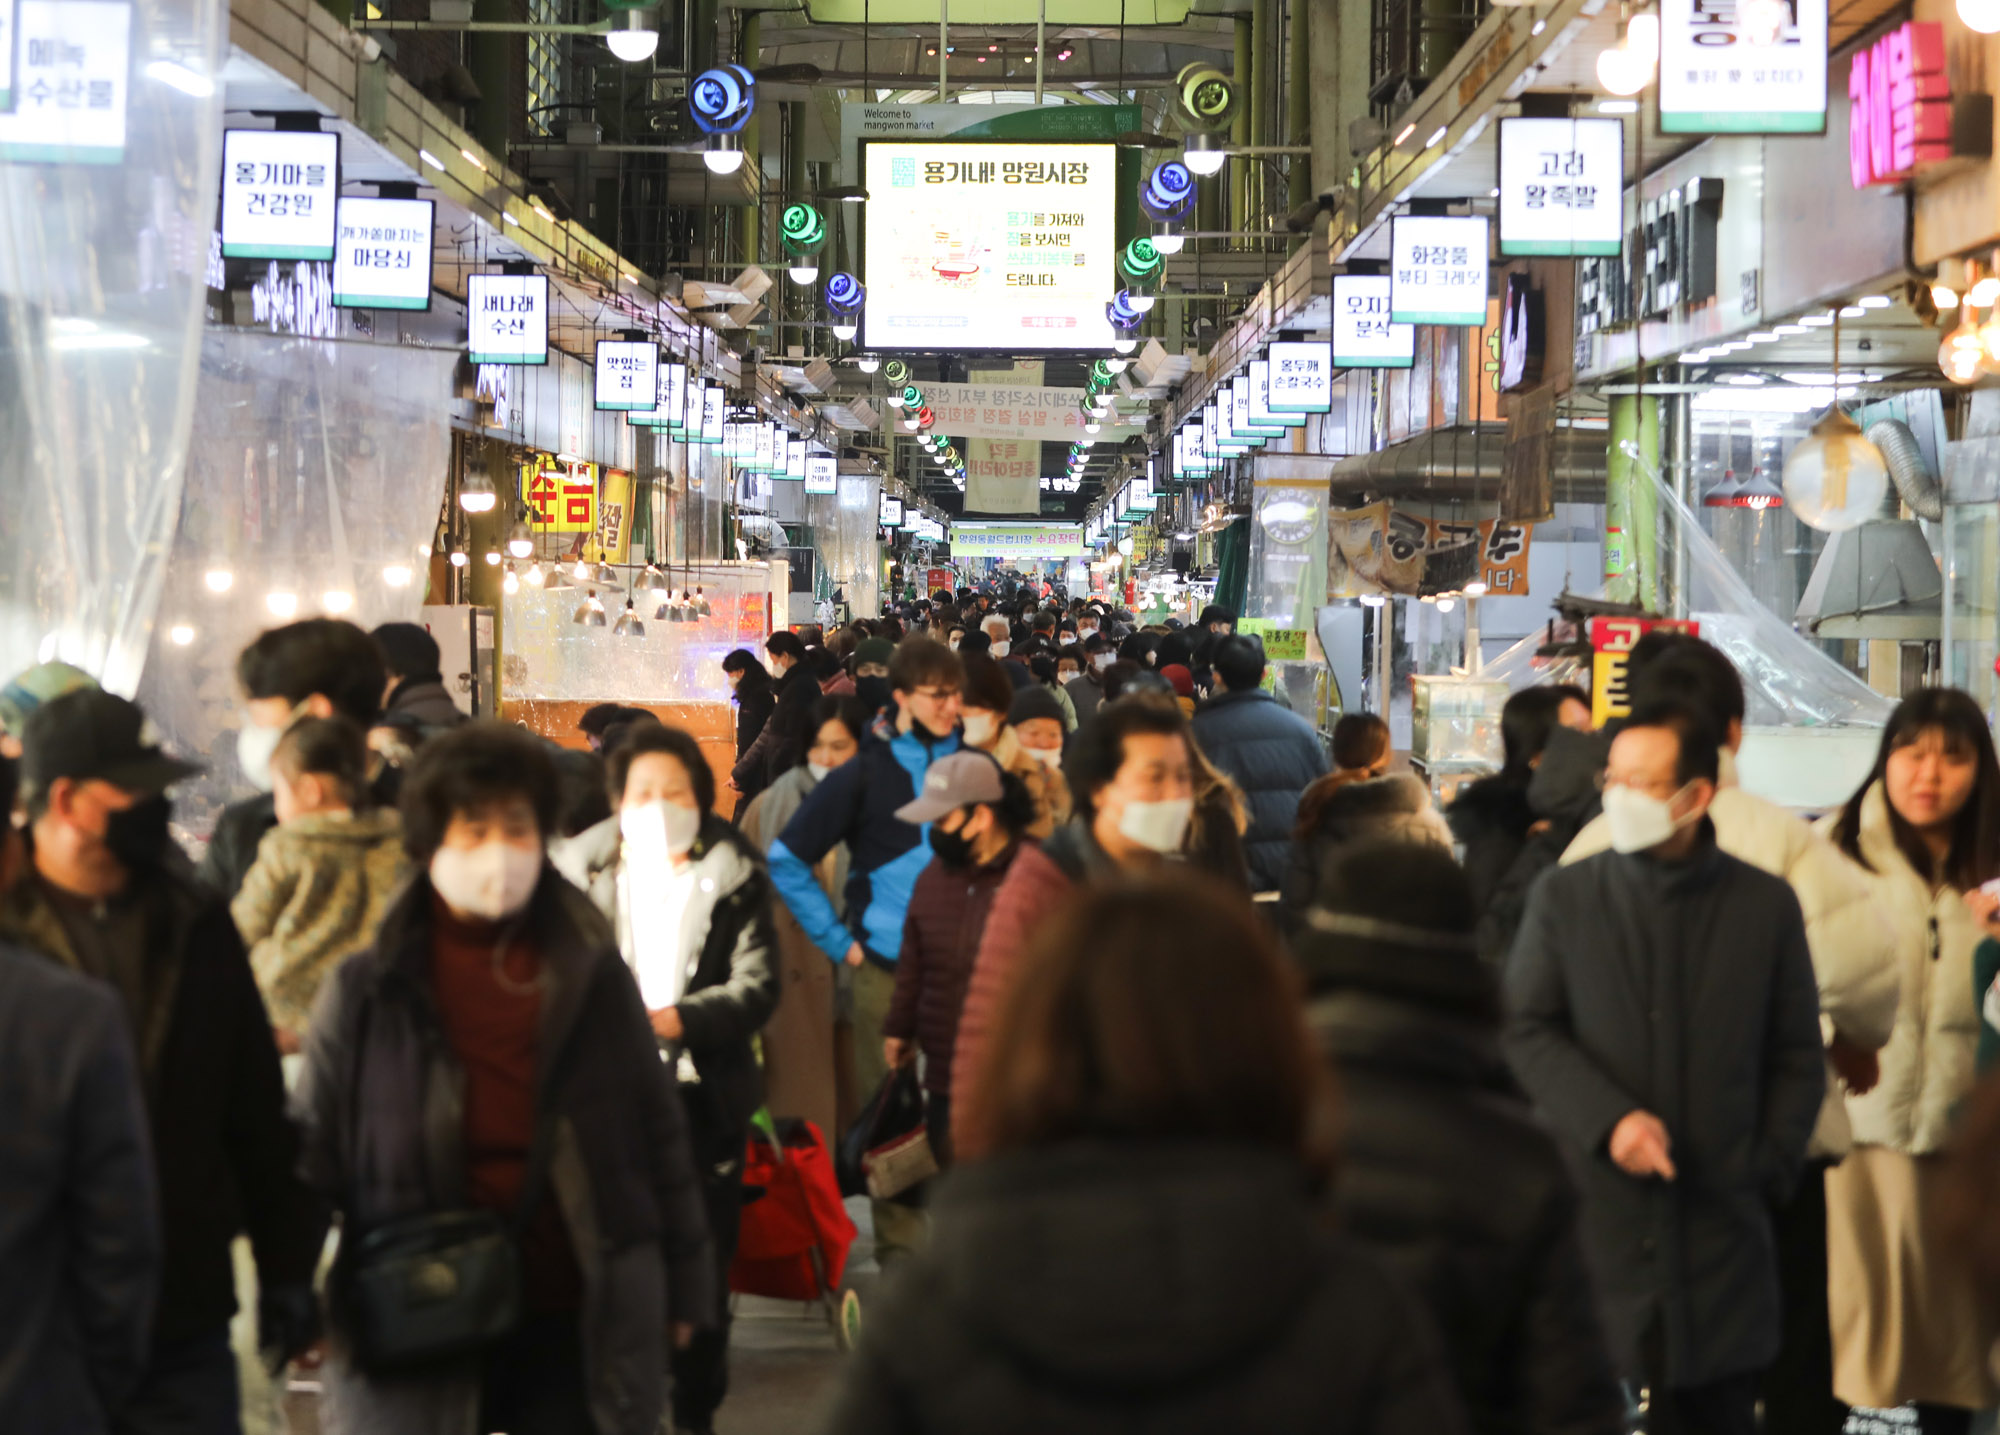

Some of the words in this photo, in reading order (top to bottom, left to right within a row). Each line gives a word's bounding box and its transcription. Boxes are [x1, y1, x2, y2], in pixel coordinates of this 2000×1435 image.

[864, 108, 901, 119] Welcome
[902, 109, 911, 119] to
[864, 121, 904, 132] mangwon
[906, 121, 934, 131] market
[1538, 150, 1584, 176] 고려
[235, 162, 326, 187] 옹기마을
[924, 161, 995, 185] 용기내!
[1002, 161, 1089, 185] 망원시장
[1526, 184, 1597, 208] 왕족발
[247, 192, 313, 217] 건강원
[1007, 211, 1045, 226] 용기를
[1048, 213, 1085, 226] 가져와
[1035, 233, 1071, 247] 보시면
[353, 247, 411, 269] 마당쇠
[1411, 245, 1468, 266] 화장품
[1006, 273, 1057, 286] 드립니다.
[1398, 269, 1427, 285] 뷰티
[1435, 269, 1481, 286] 크레딧
[482, 295, 534, 313] 새나래
[490, 317, 525, 336] 수산
[607, 356, 647, 371] 맛있는
[1281, 359, 1319, 372] 홍두깨
[620, 375, 632, 388] 집
[1274, 376, 1325, 389] 손칼국수
[958, 533, 1033, 545] 망원동월드컵시장
[1036, 532, 1080, 545] 수요장터
